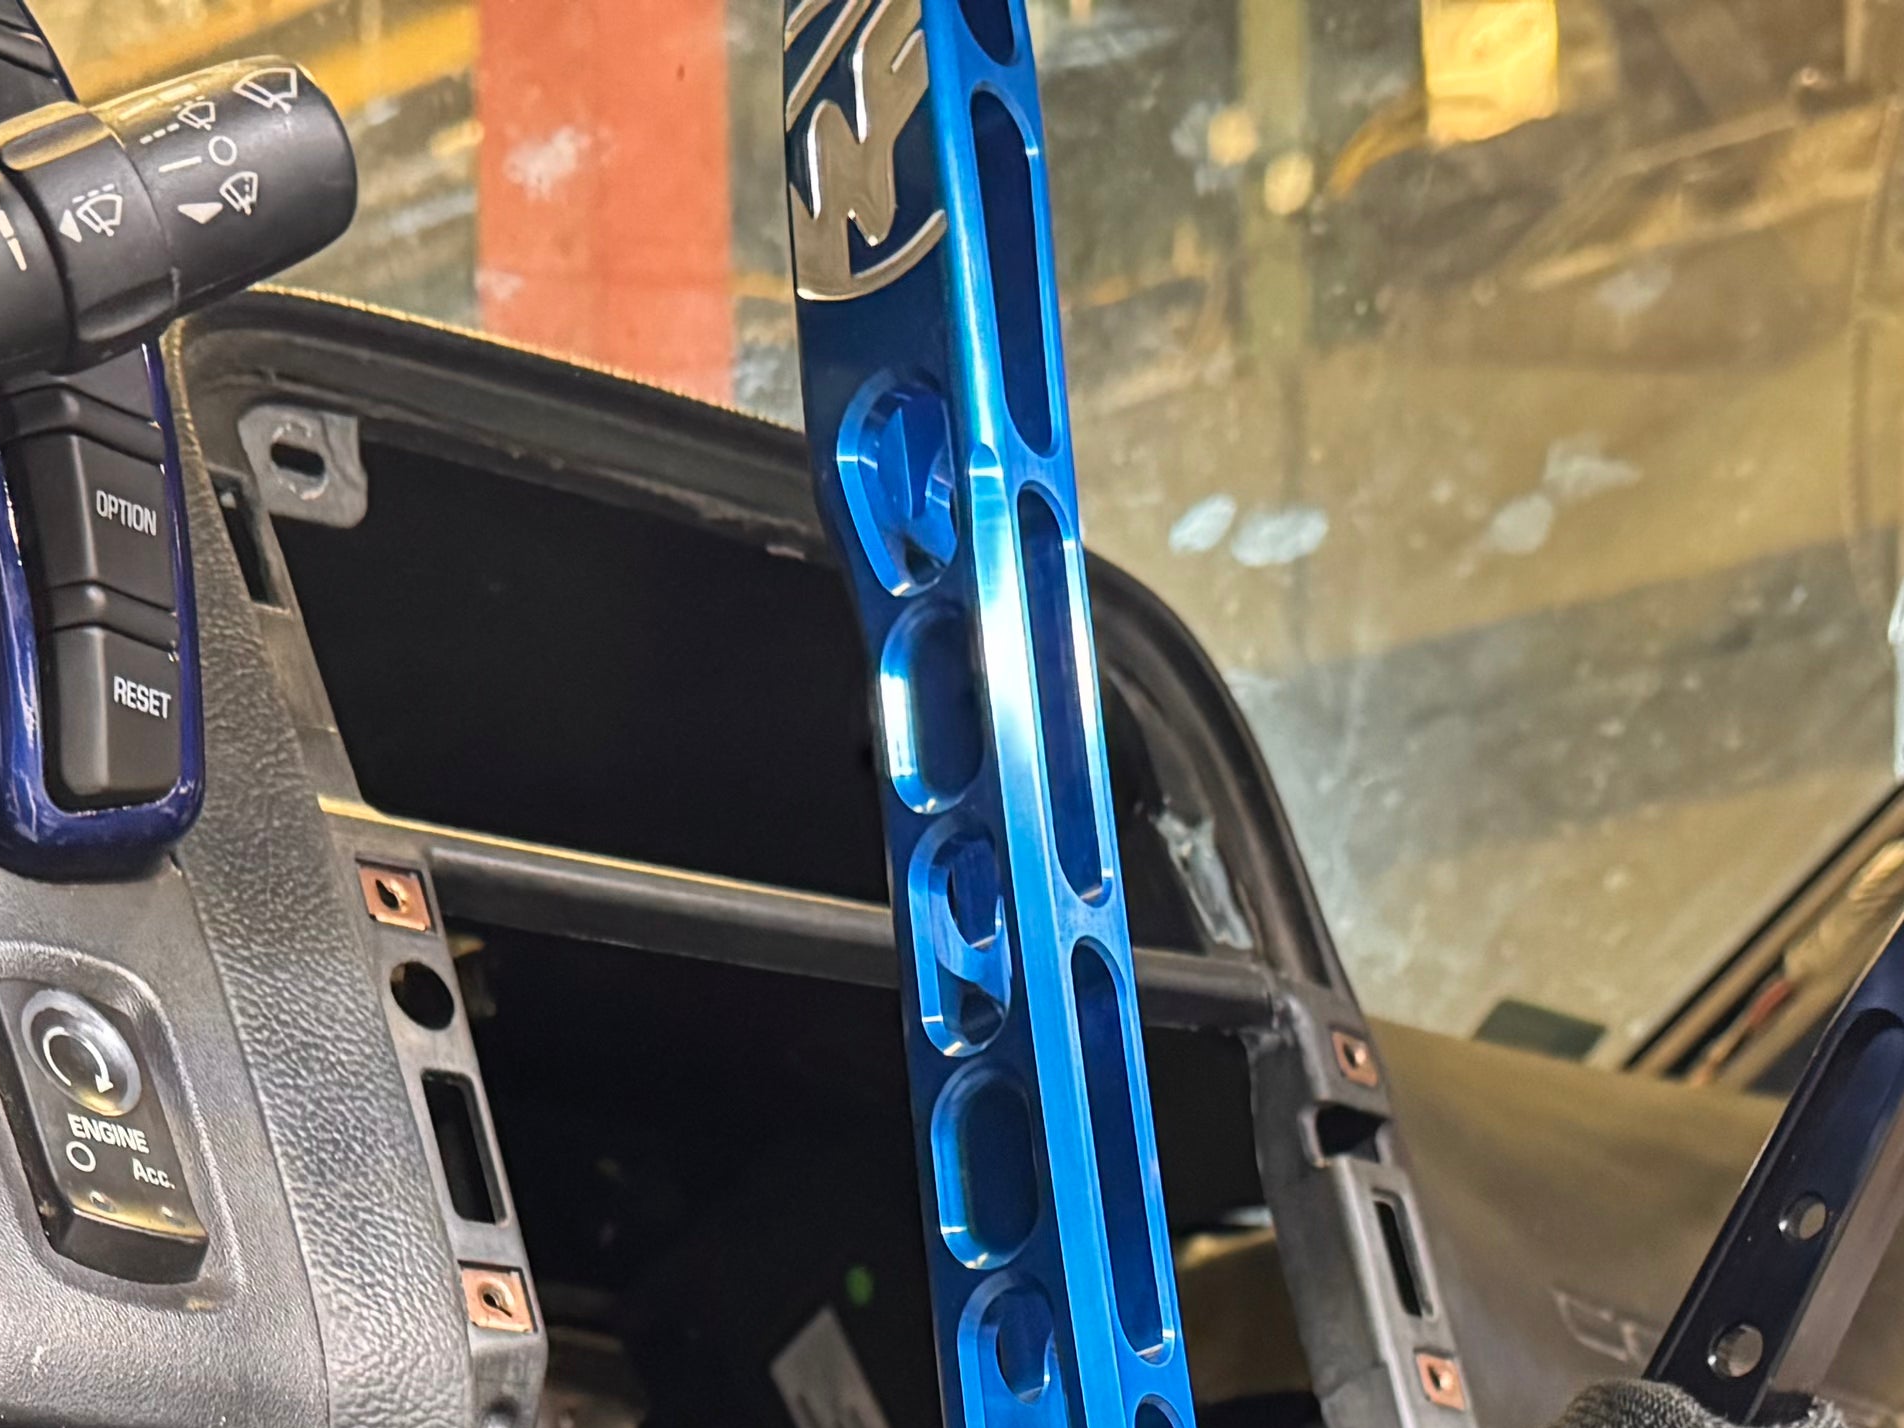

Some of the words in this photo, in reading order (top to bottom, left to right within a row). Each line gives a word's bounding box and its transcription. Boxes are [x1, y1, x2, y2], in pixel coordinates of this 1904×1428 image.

[96, 489, 157, 537] OPTION
[114, 675, 172, 719] RESET
[67, 1112, 150, 1154] ENGINE
[132, 1157, 176, 1190] Acc.
